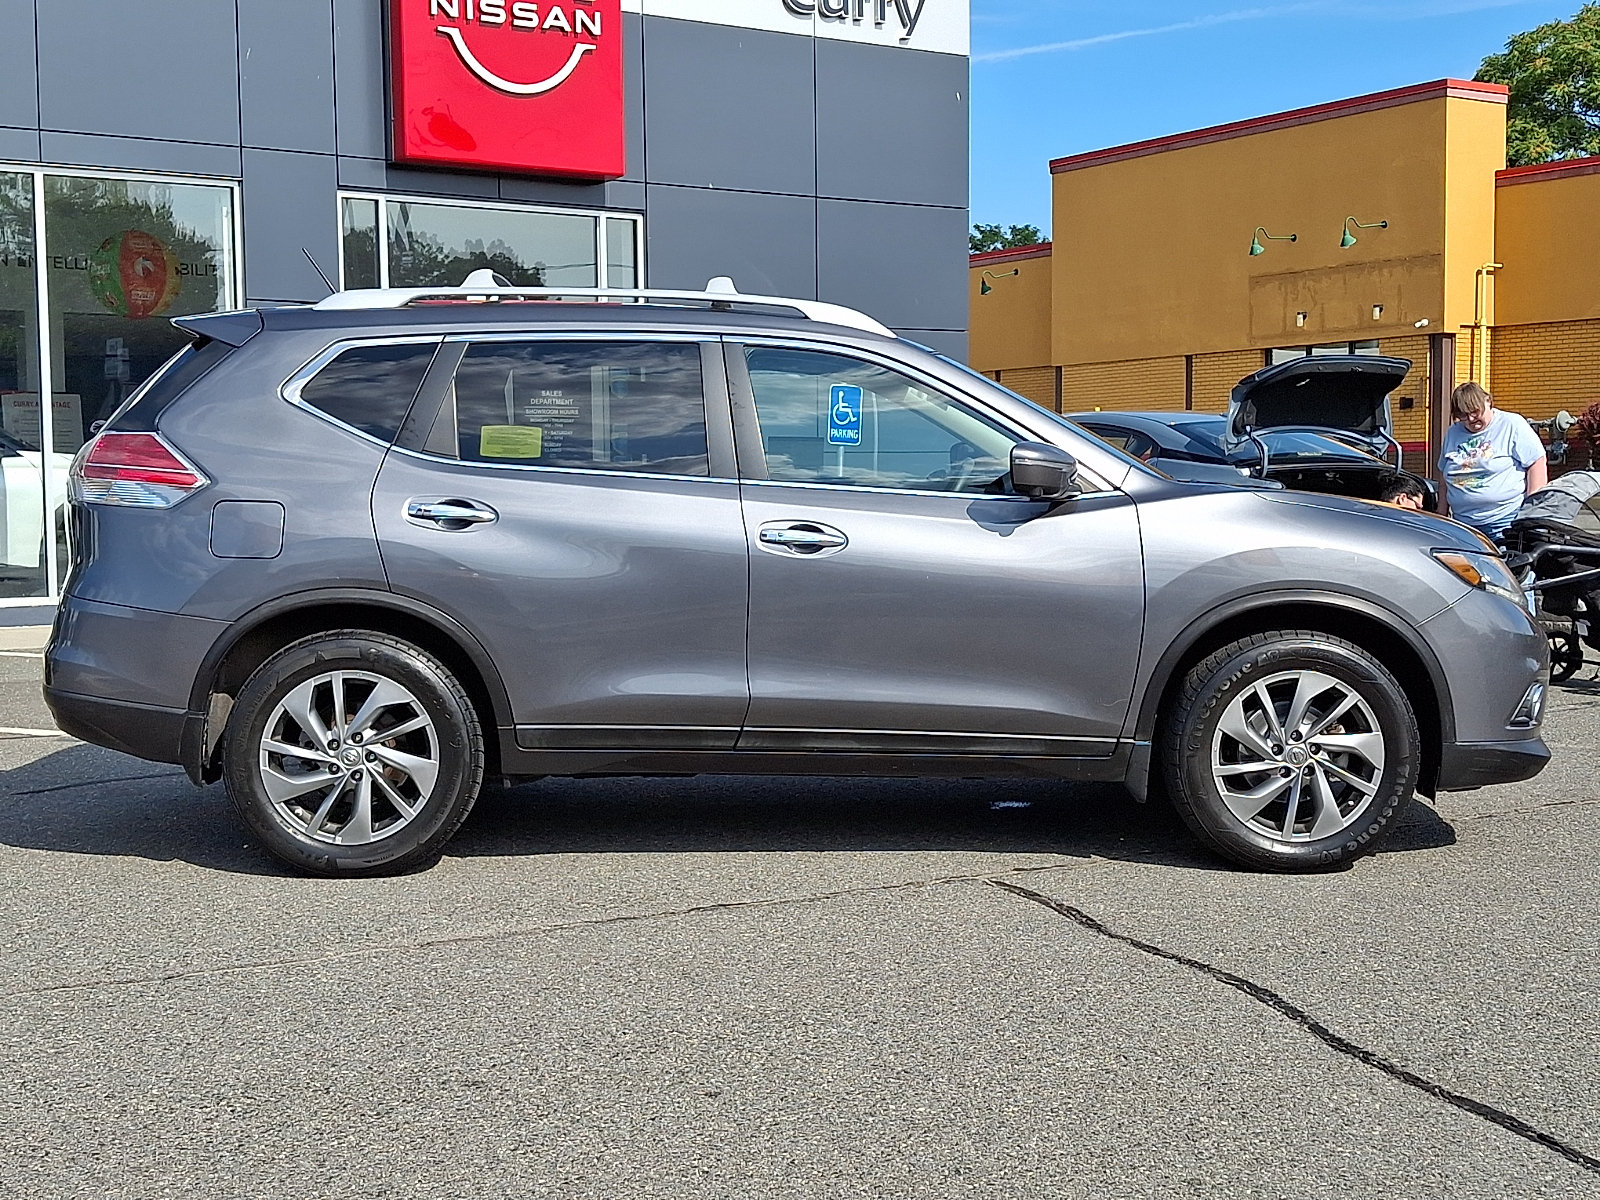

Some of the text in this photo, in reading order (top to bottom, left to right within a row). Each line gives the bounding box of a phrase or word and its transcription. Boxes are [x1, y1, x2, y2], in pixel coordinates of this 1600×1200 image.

[430, 0, 602, 36] NISSAN
[530, 398, 574, 406] DEPARTMENT
[831, 428, 858, 439] PARKING
